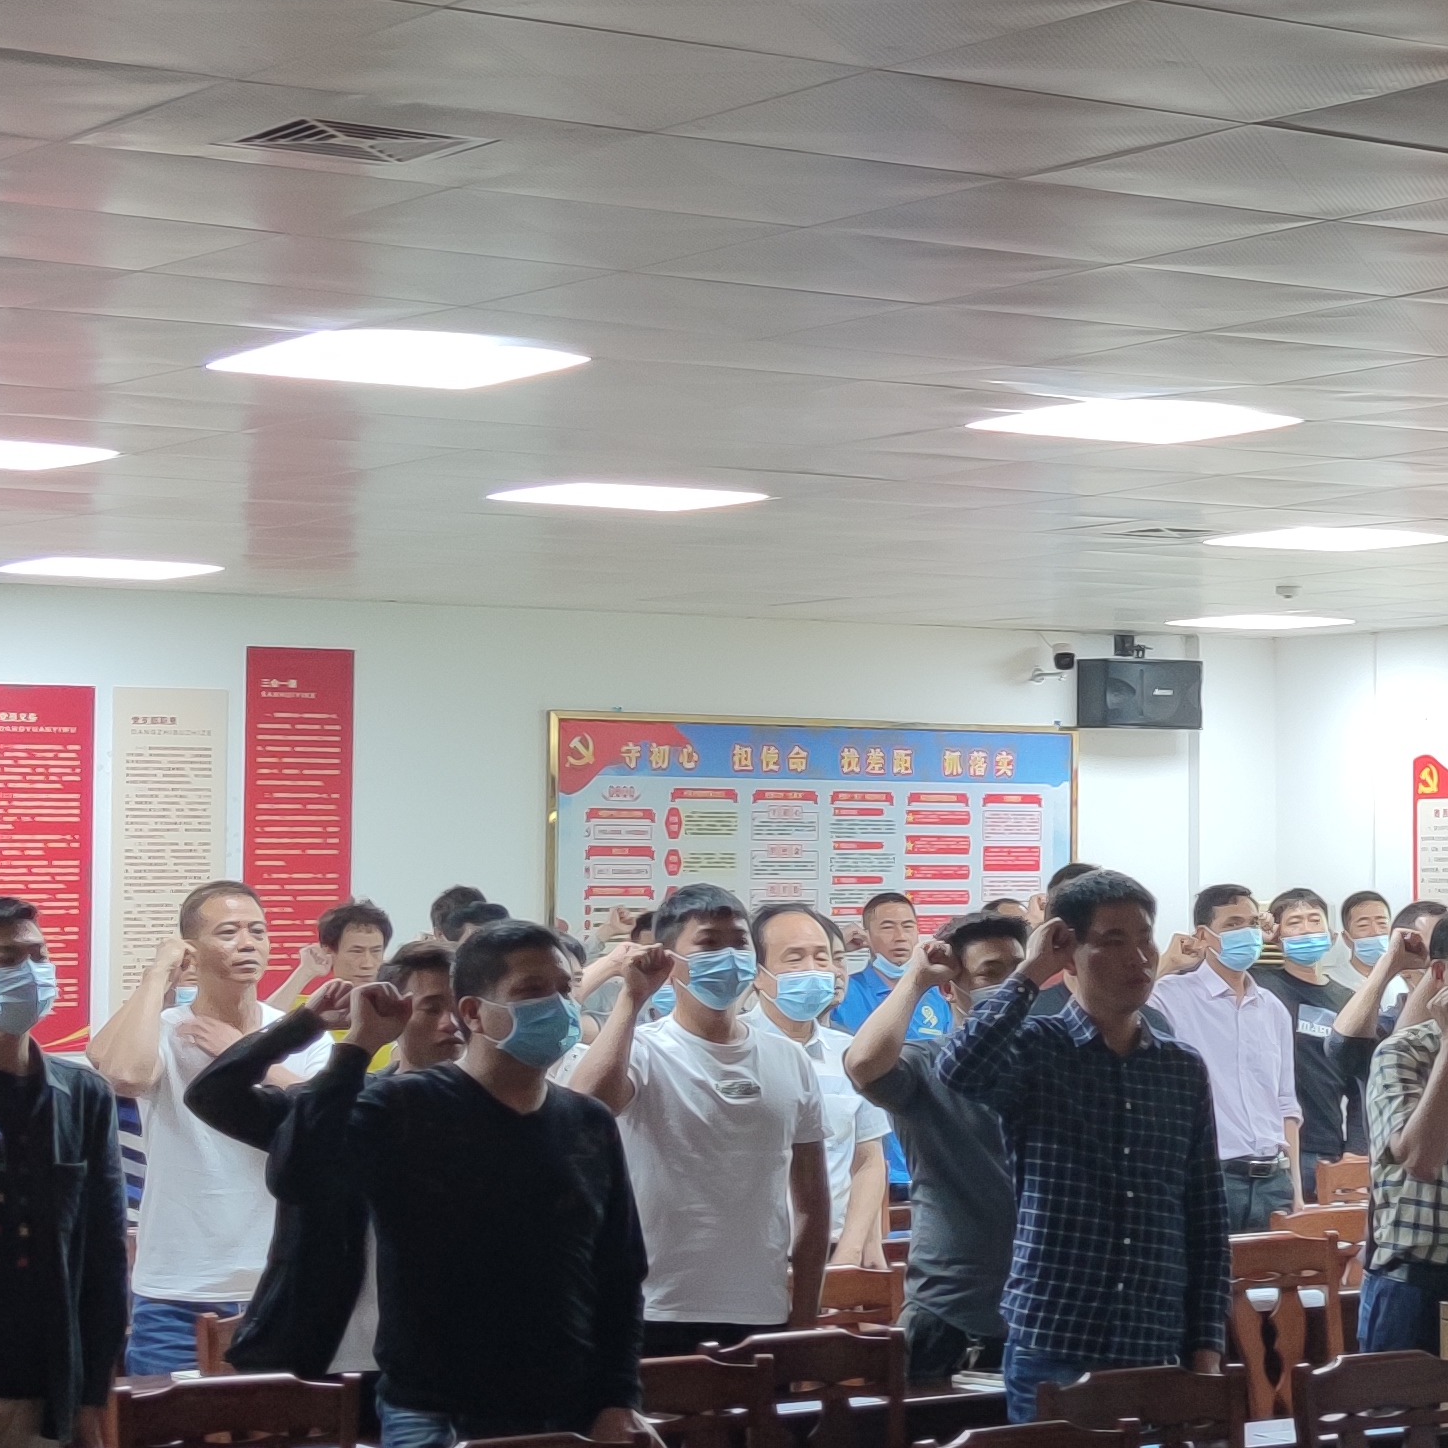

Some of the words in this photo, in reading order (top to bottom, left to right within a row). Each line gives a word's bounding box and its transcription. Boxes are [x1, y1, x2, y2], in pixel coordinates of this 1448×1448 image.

[619, 742, 700, 771] 守初心
[732, 743, 810, 773] 担使命
[839, 746, 914, 777] 找差距
[942, 748, 1016, 778] 抓落实
